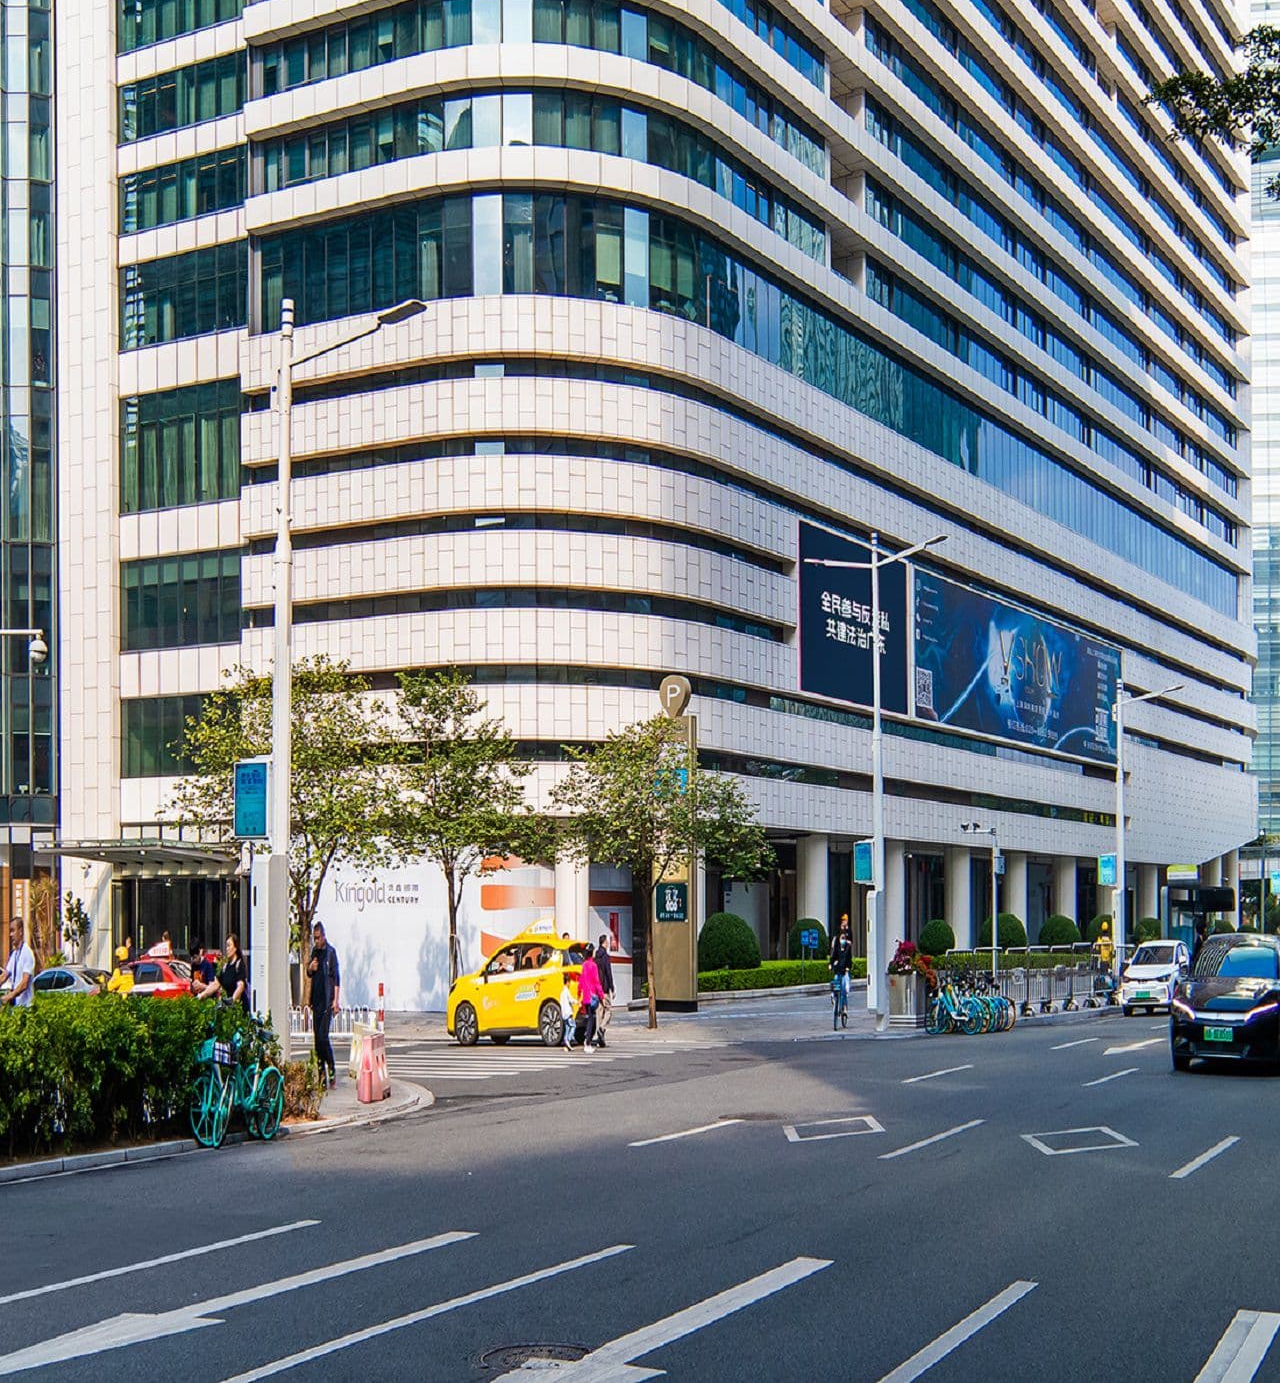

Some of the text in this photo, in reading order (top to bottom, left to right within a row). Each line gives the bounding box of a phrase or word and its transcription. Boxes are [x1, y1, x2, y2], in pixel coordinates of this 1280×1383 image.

[820, 591, 890, 632] 全民参与反私
[666, 684, 681, 708] P
[335, 881, 385, 912] Kingold
[387, 896, 419, 904] CENTURY
